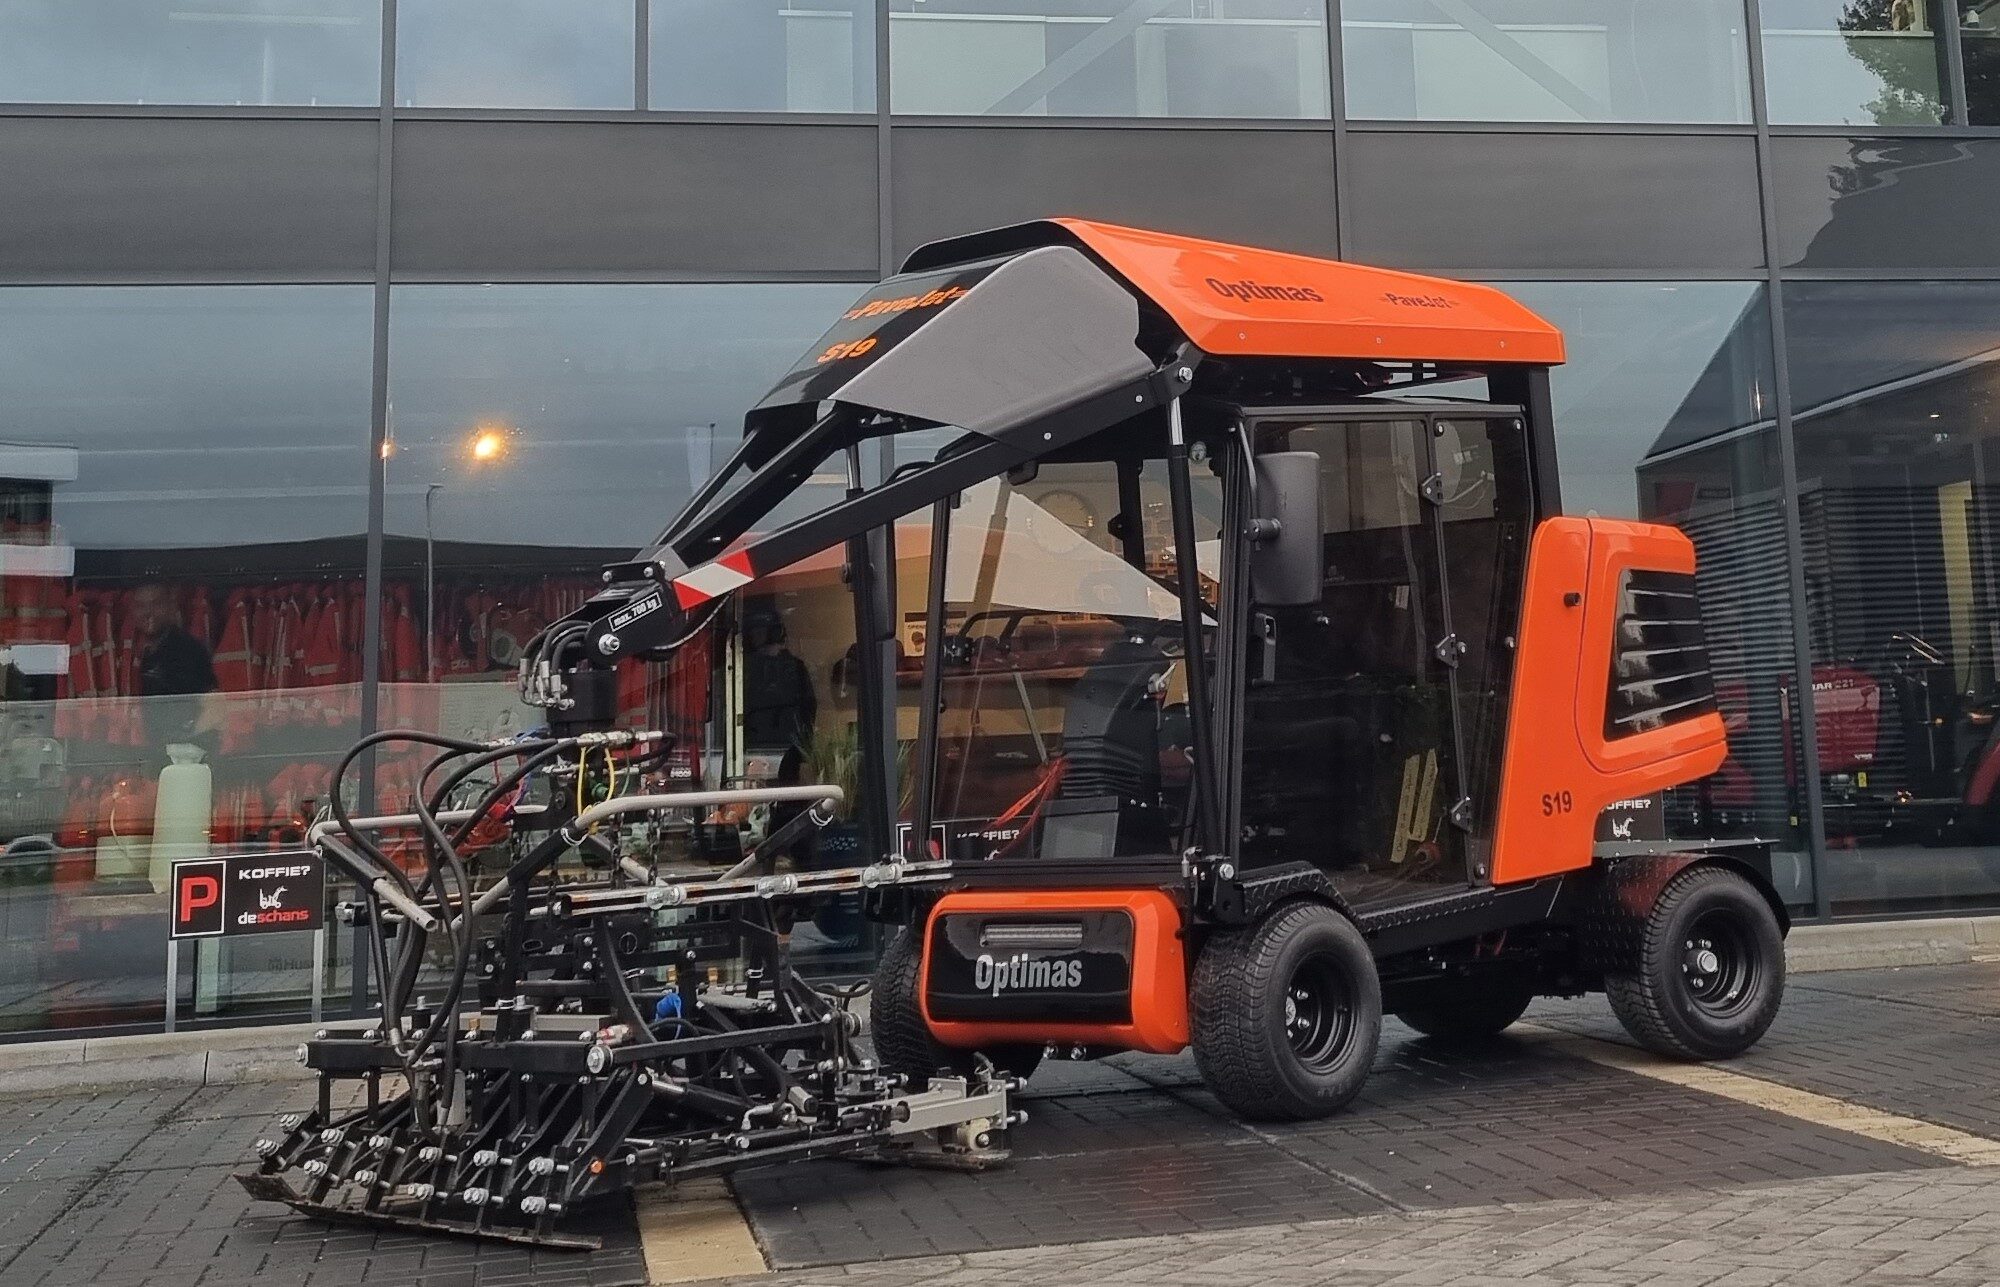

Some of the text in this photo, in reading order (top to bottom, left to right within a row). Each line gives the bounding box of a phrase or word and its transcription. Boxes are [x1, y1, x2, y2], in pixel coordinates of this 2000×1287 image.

[1205, 277, 1325, 303] Optimas
[817, 338, 877, 364] S19
[631, 602, 647, 617] 700
[646, 598, 658, 611] kg
[1542, 790, 1572, 817] S19
[238, 865, 311, 880] KOFFIE?
[180, 876, 218, 922] P
[237, 909, 309, 925] deschans
[975, 953, 1082, 998] Optimas
